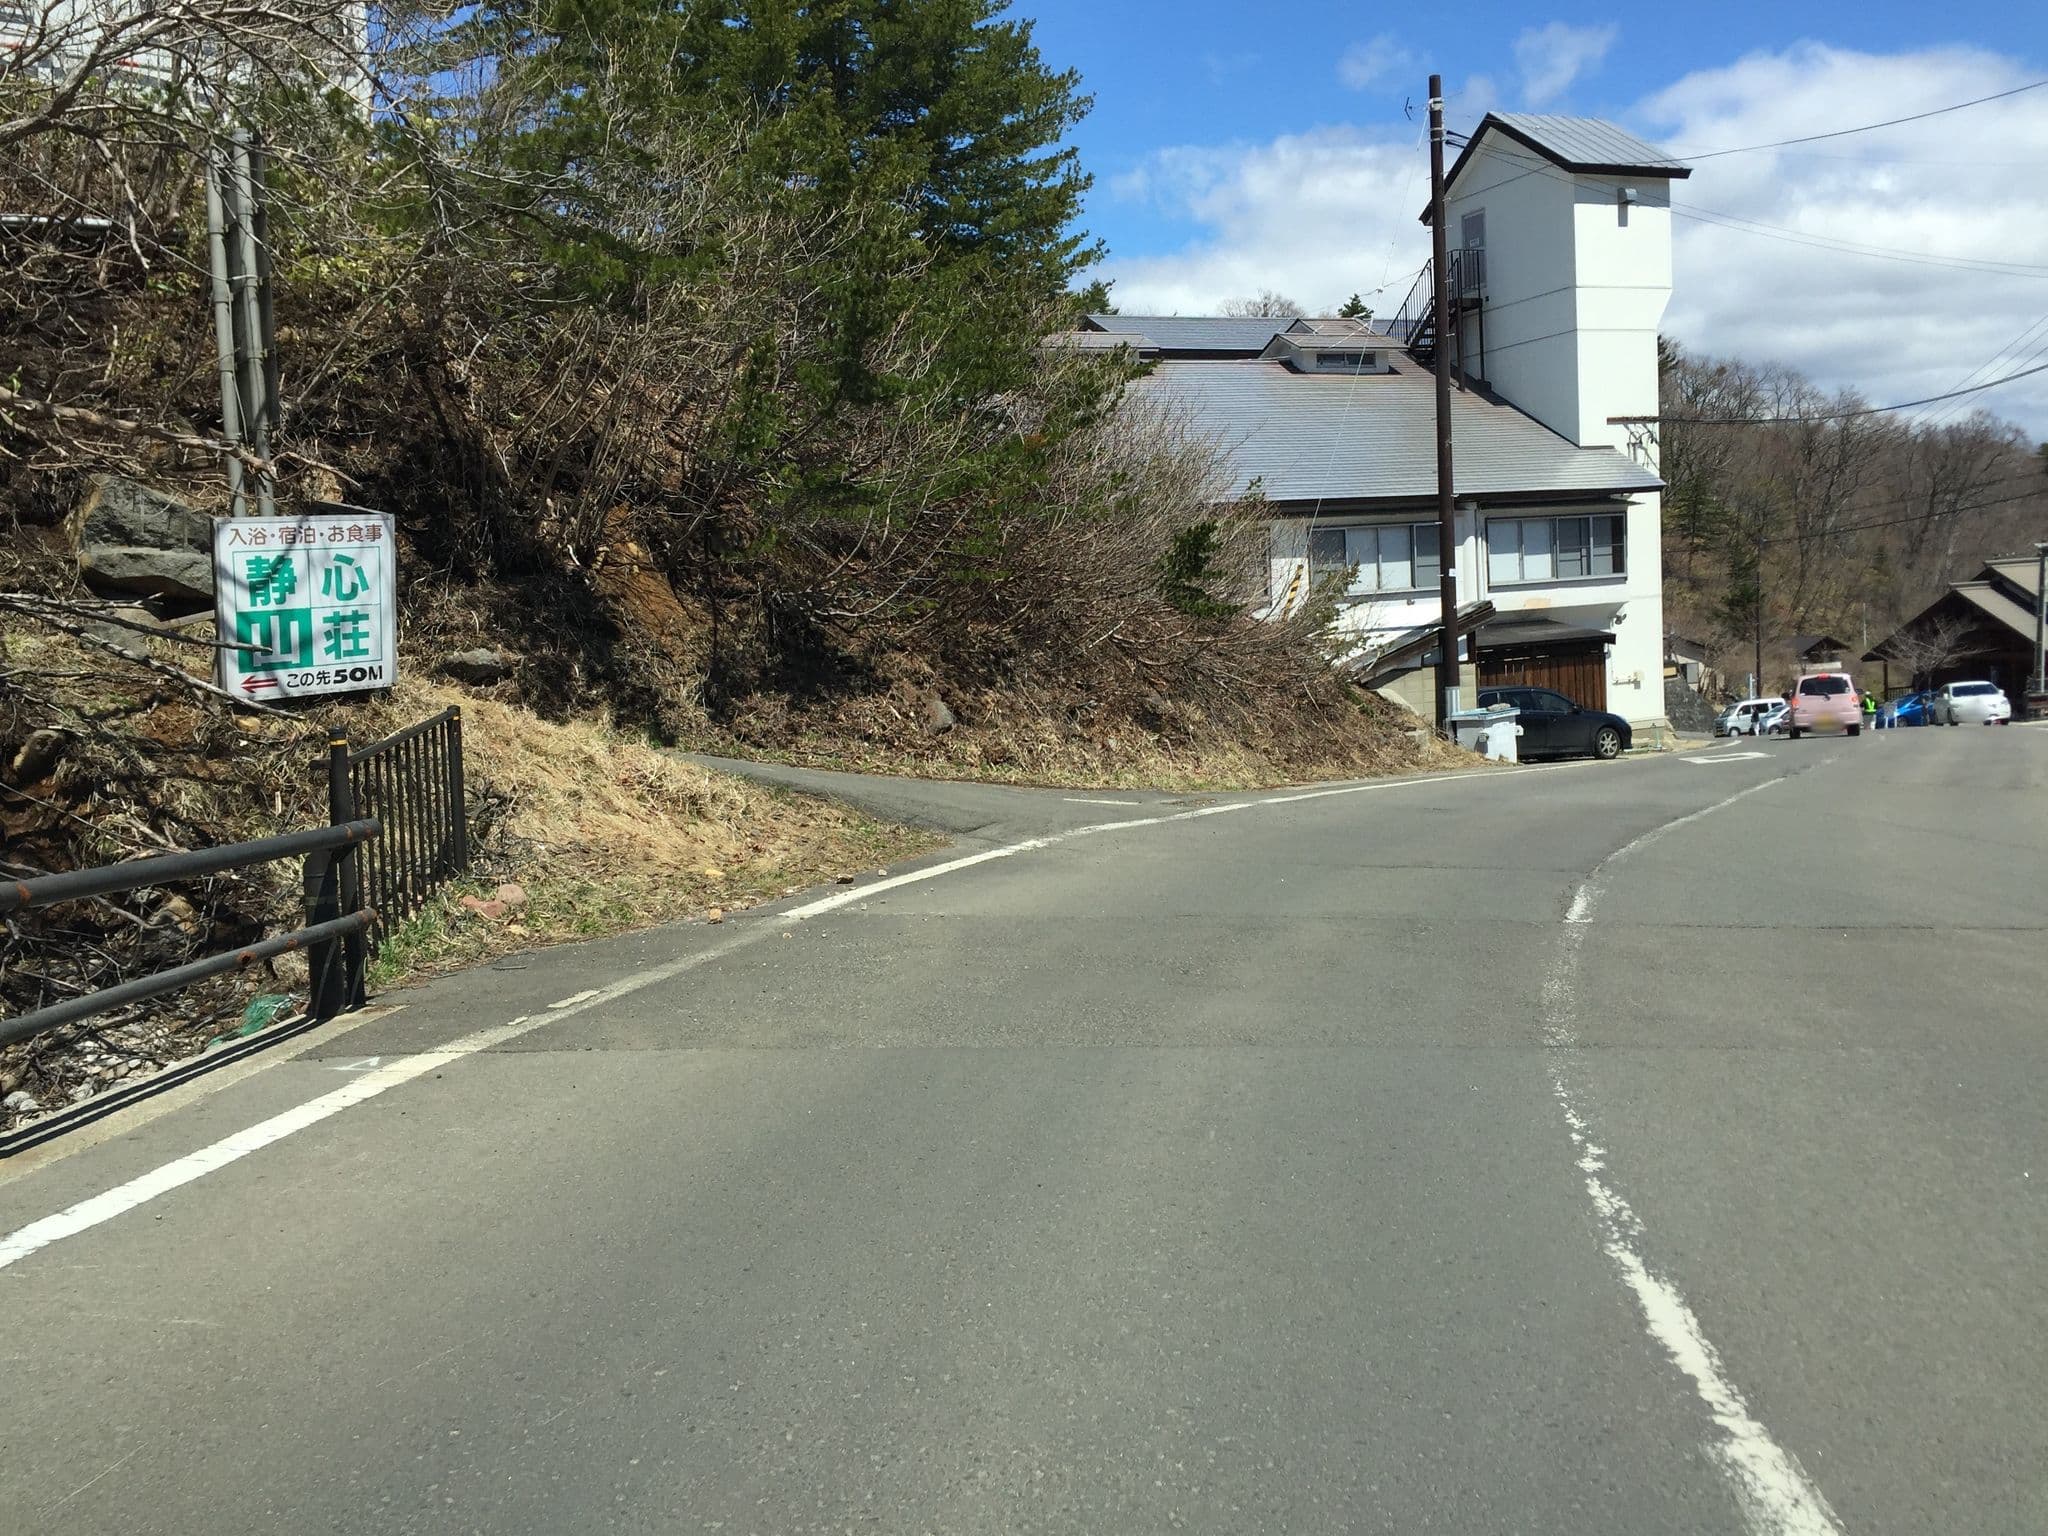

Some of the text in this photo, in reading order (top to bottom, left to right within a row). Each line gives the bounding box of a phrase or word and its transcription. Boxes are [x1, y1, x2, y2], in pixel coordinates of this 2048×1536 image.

[228, 524, 383, 546] 入浴・宿泊・お食事
